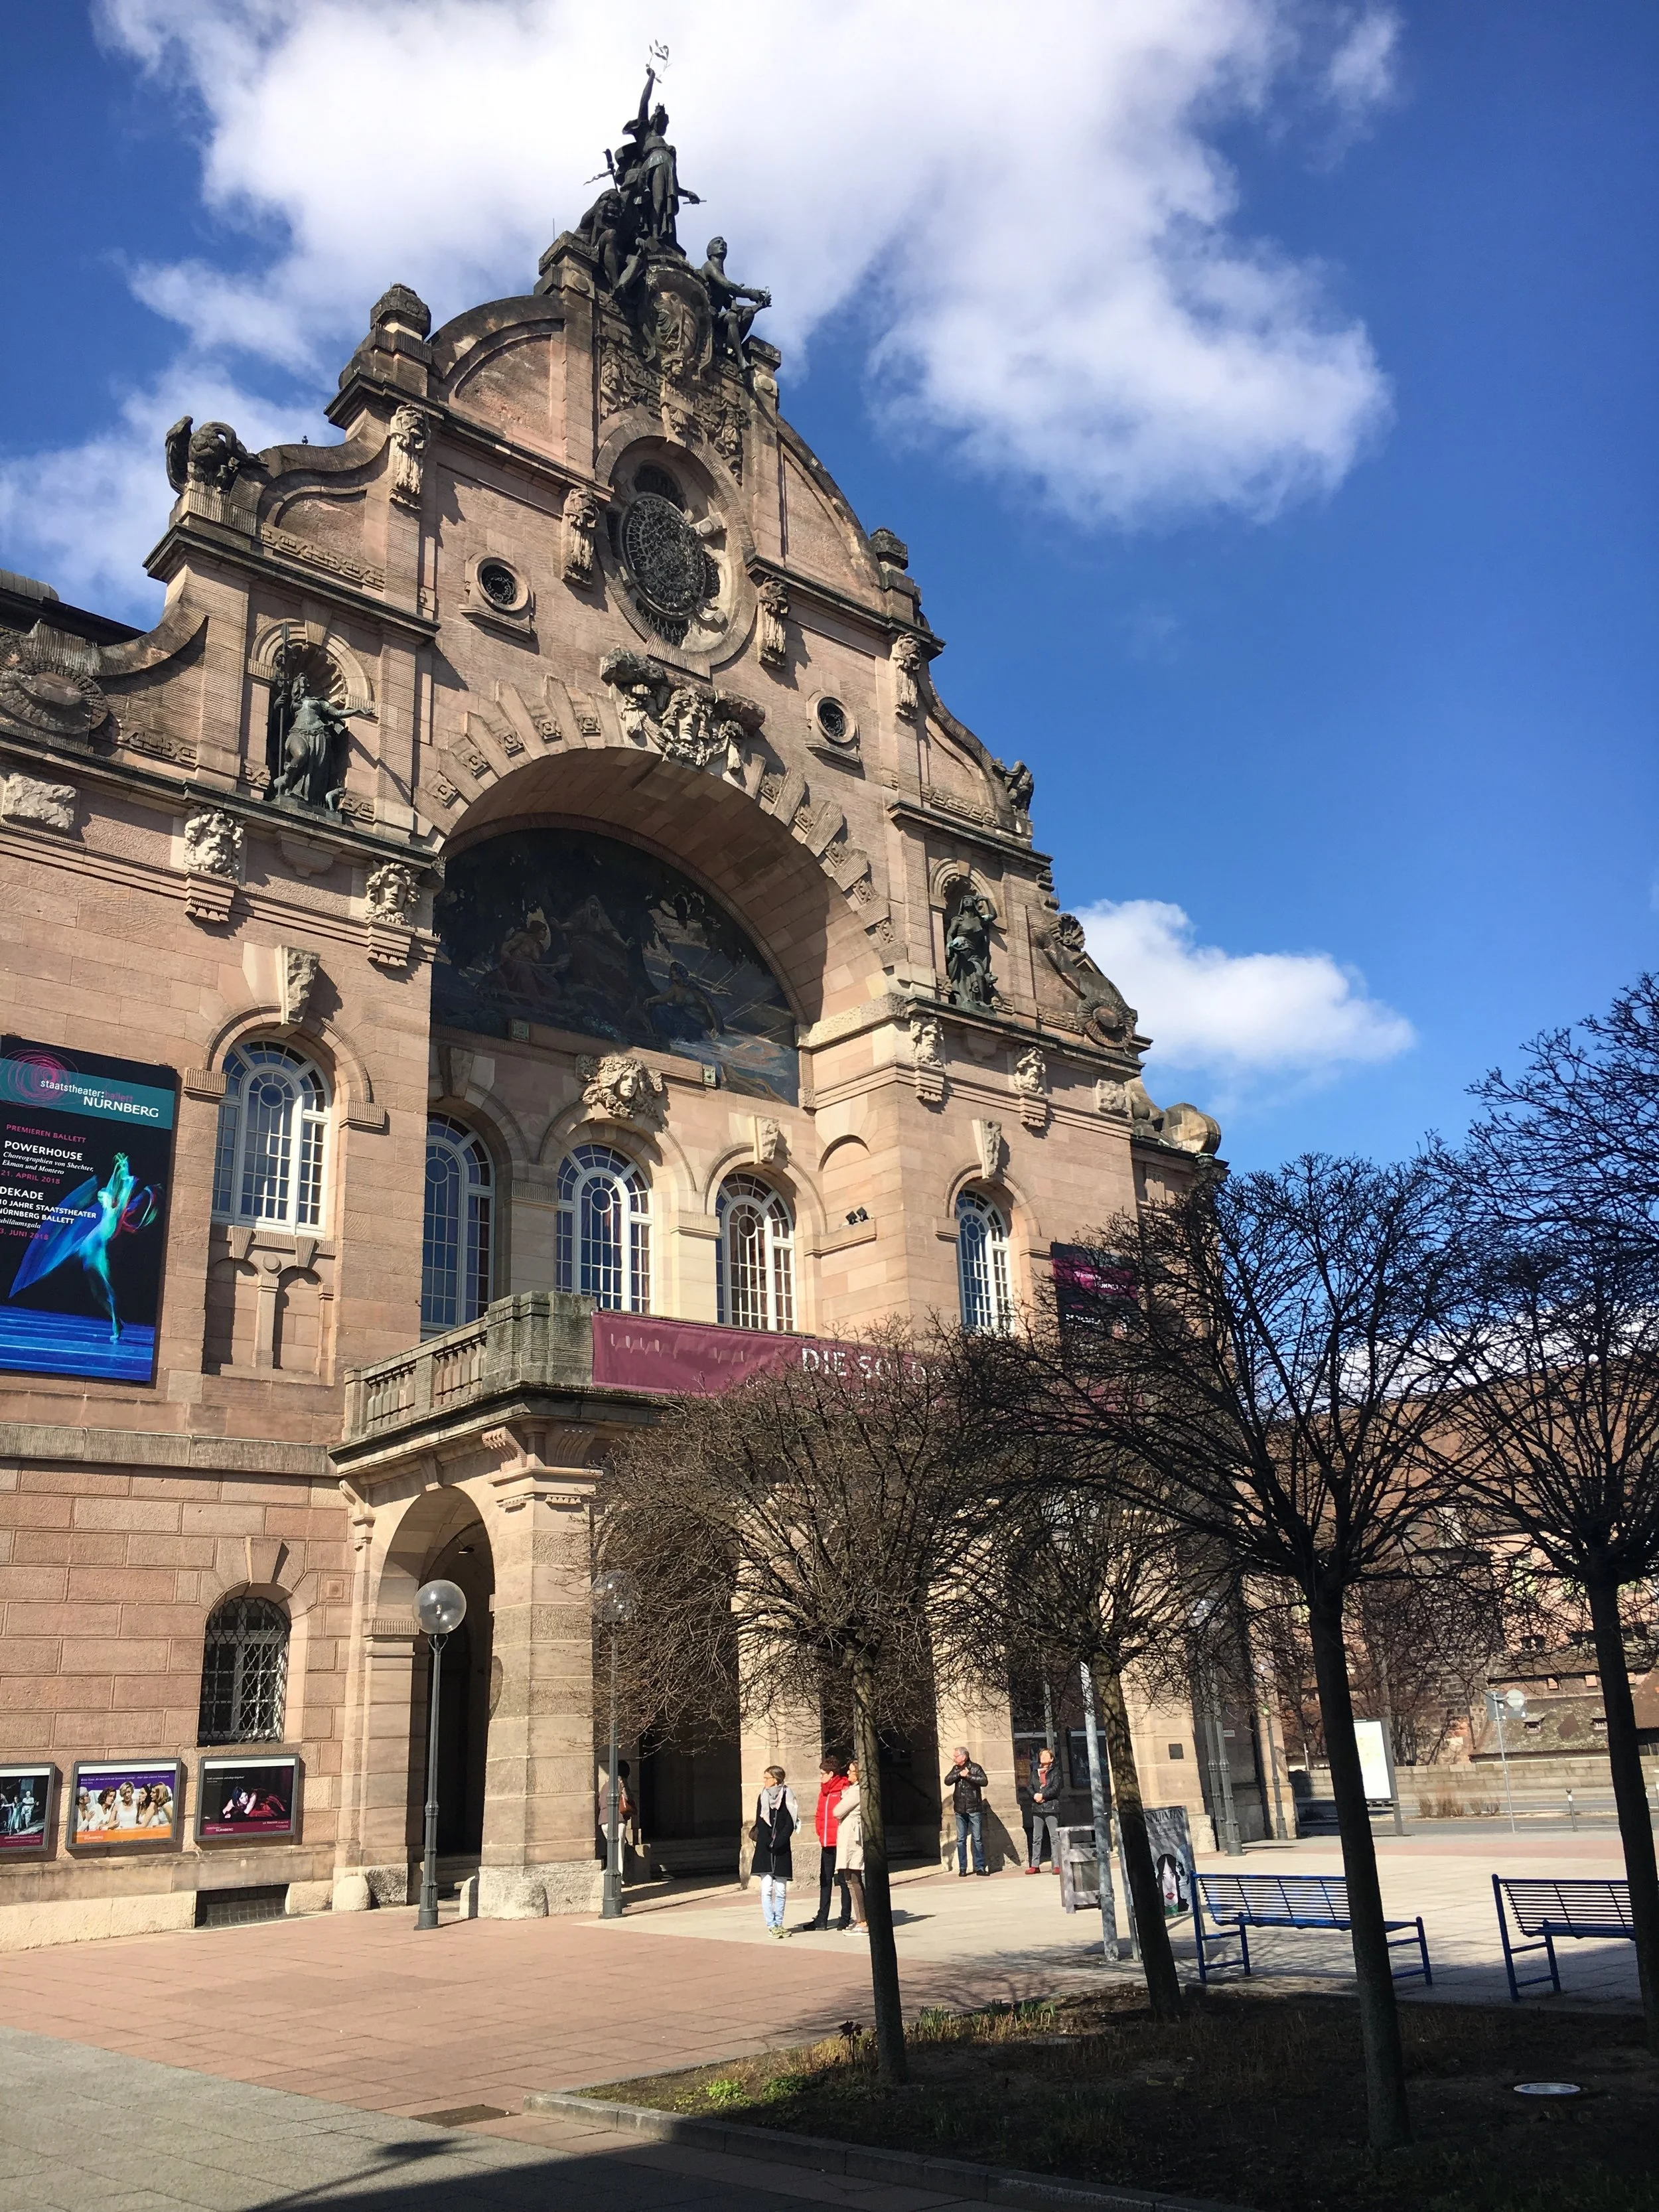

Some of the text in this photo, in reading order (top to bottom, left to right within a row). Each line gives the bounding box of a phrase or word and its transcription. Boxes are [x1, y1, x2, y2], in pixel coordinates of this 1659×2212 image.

[6, 1124, 86, 1143] PREMIEREN BALLETT
[3, 1151, 53, 1165] Choreographien
[5, 1140, 83, 1161] POWERHOUSE
[1, 1159, 24, 1168] Ekman
[38, 1166, 64, 1175] Montero
[15, 1172, 38, 1181] APRIL
[41, 1176, 60, 1185] 2018
[0, 1186, 44, 1201] DEKADE
[9, 1200, 34, 1210] JAHRE
[35, 1204, 97, 1218] STAATSTHEATER
[0, 1218, 41, 1228] ubiläumsgala
[41, 1214, 74, 1224] BALLETT
[30, 1232, 48, 1240] 2018
[802, 1347, 847, 1376] DIE
